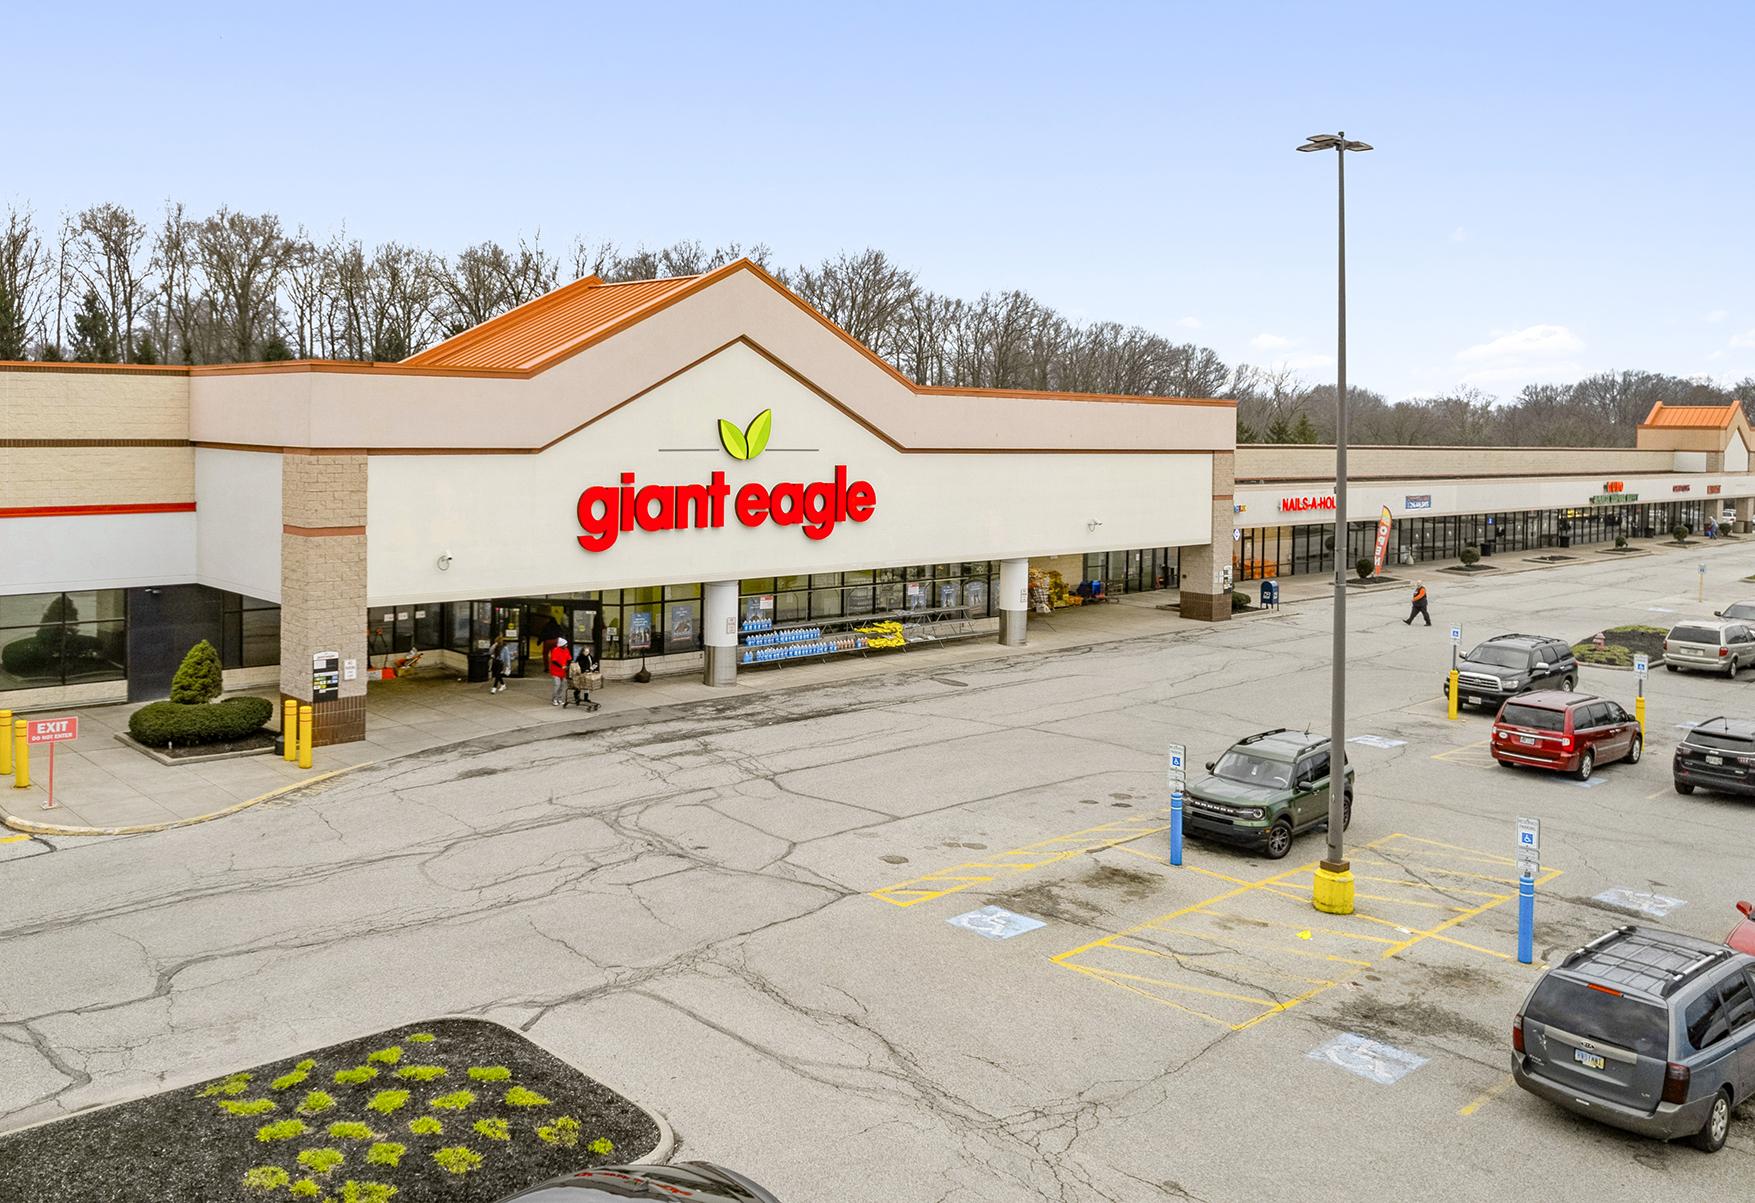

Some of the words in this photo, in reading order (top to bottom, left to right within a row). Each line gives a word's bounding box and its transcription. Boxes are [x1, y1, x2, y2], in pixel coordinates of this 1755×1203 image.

[577, 470, 731, 553] giant
[735, 464, 876, 541] eagle
[1374, 525, 1388, 566] OPEN
[37, 720, 69, 734] EXIT
